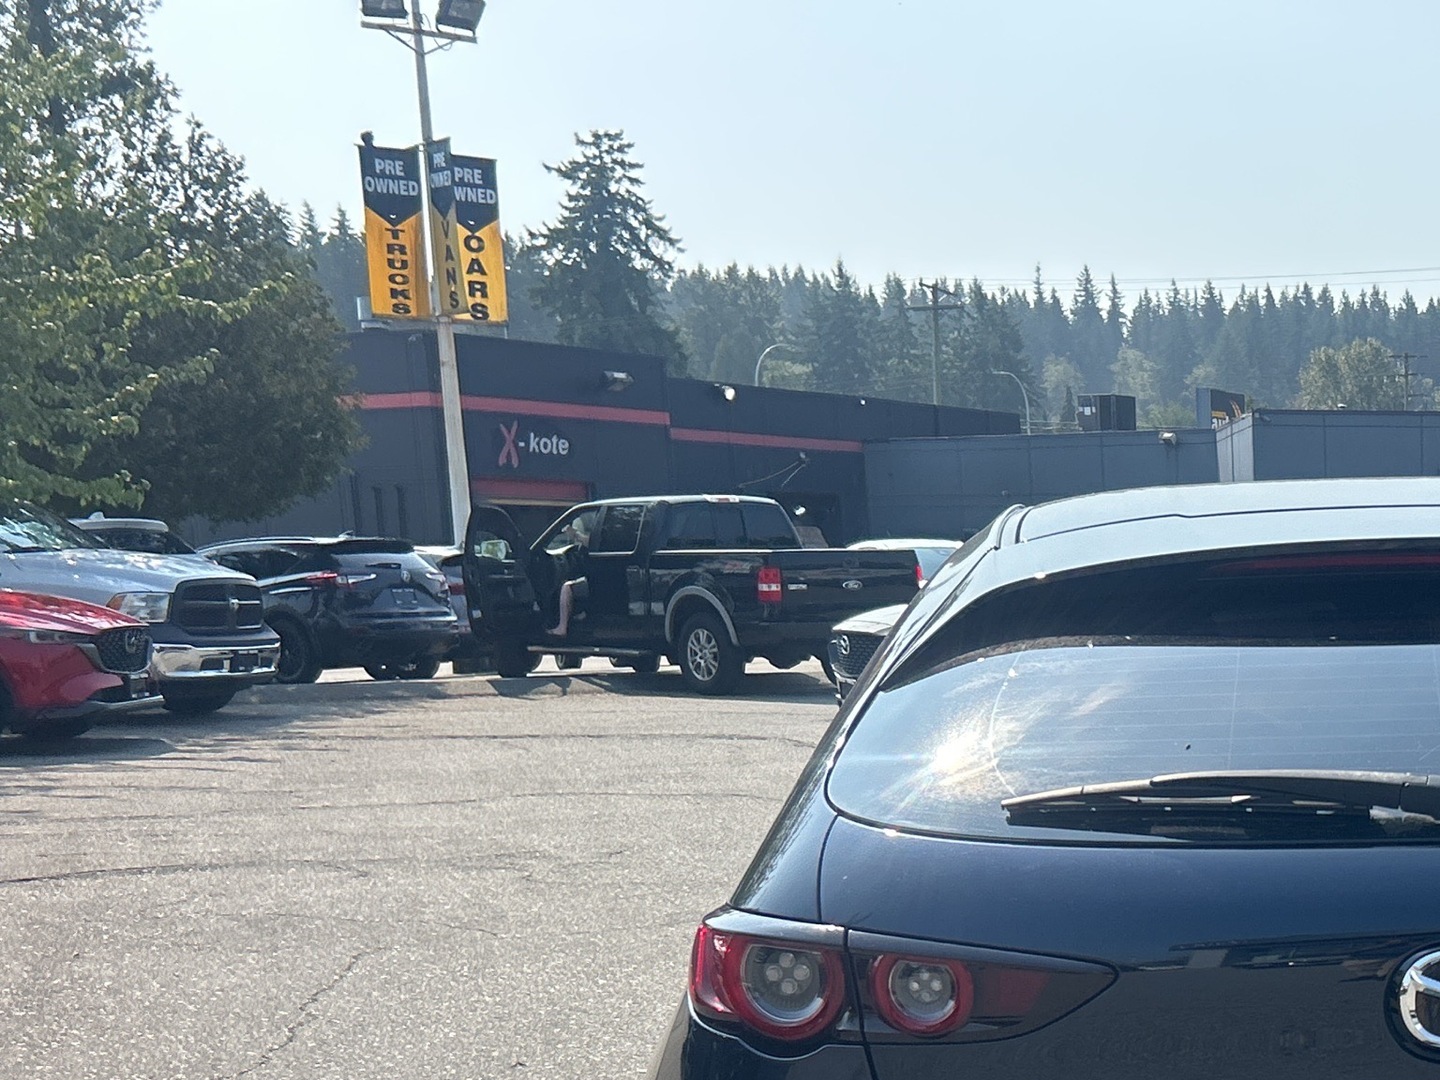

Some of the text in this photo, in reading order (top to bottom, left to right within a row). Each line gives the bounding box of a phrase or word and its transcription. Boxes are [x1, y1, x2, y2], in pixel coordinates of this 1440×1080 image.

[374, 158, 404, 176] PRE
[432, 152, 446, 168] PRE
[453, 167, 483, 184] PRE
[365, 176, 418, 196] OWNED
[454, 186, 496, 204] WNED
[441, 221, 459, 309] VANS
